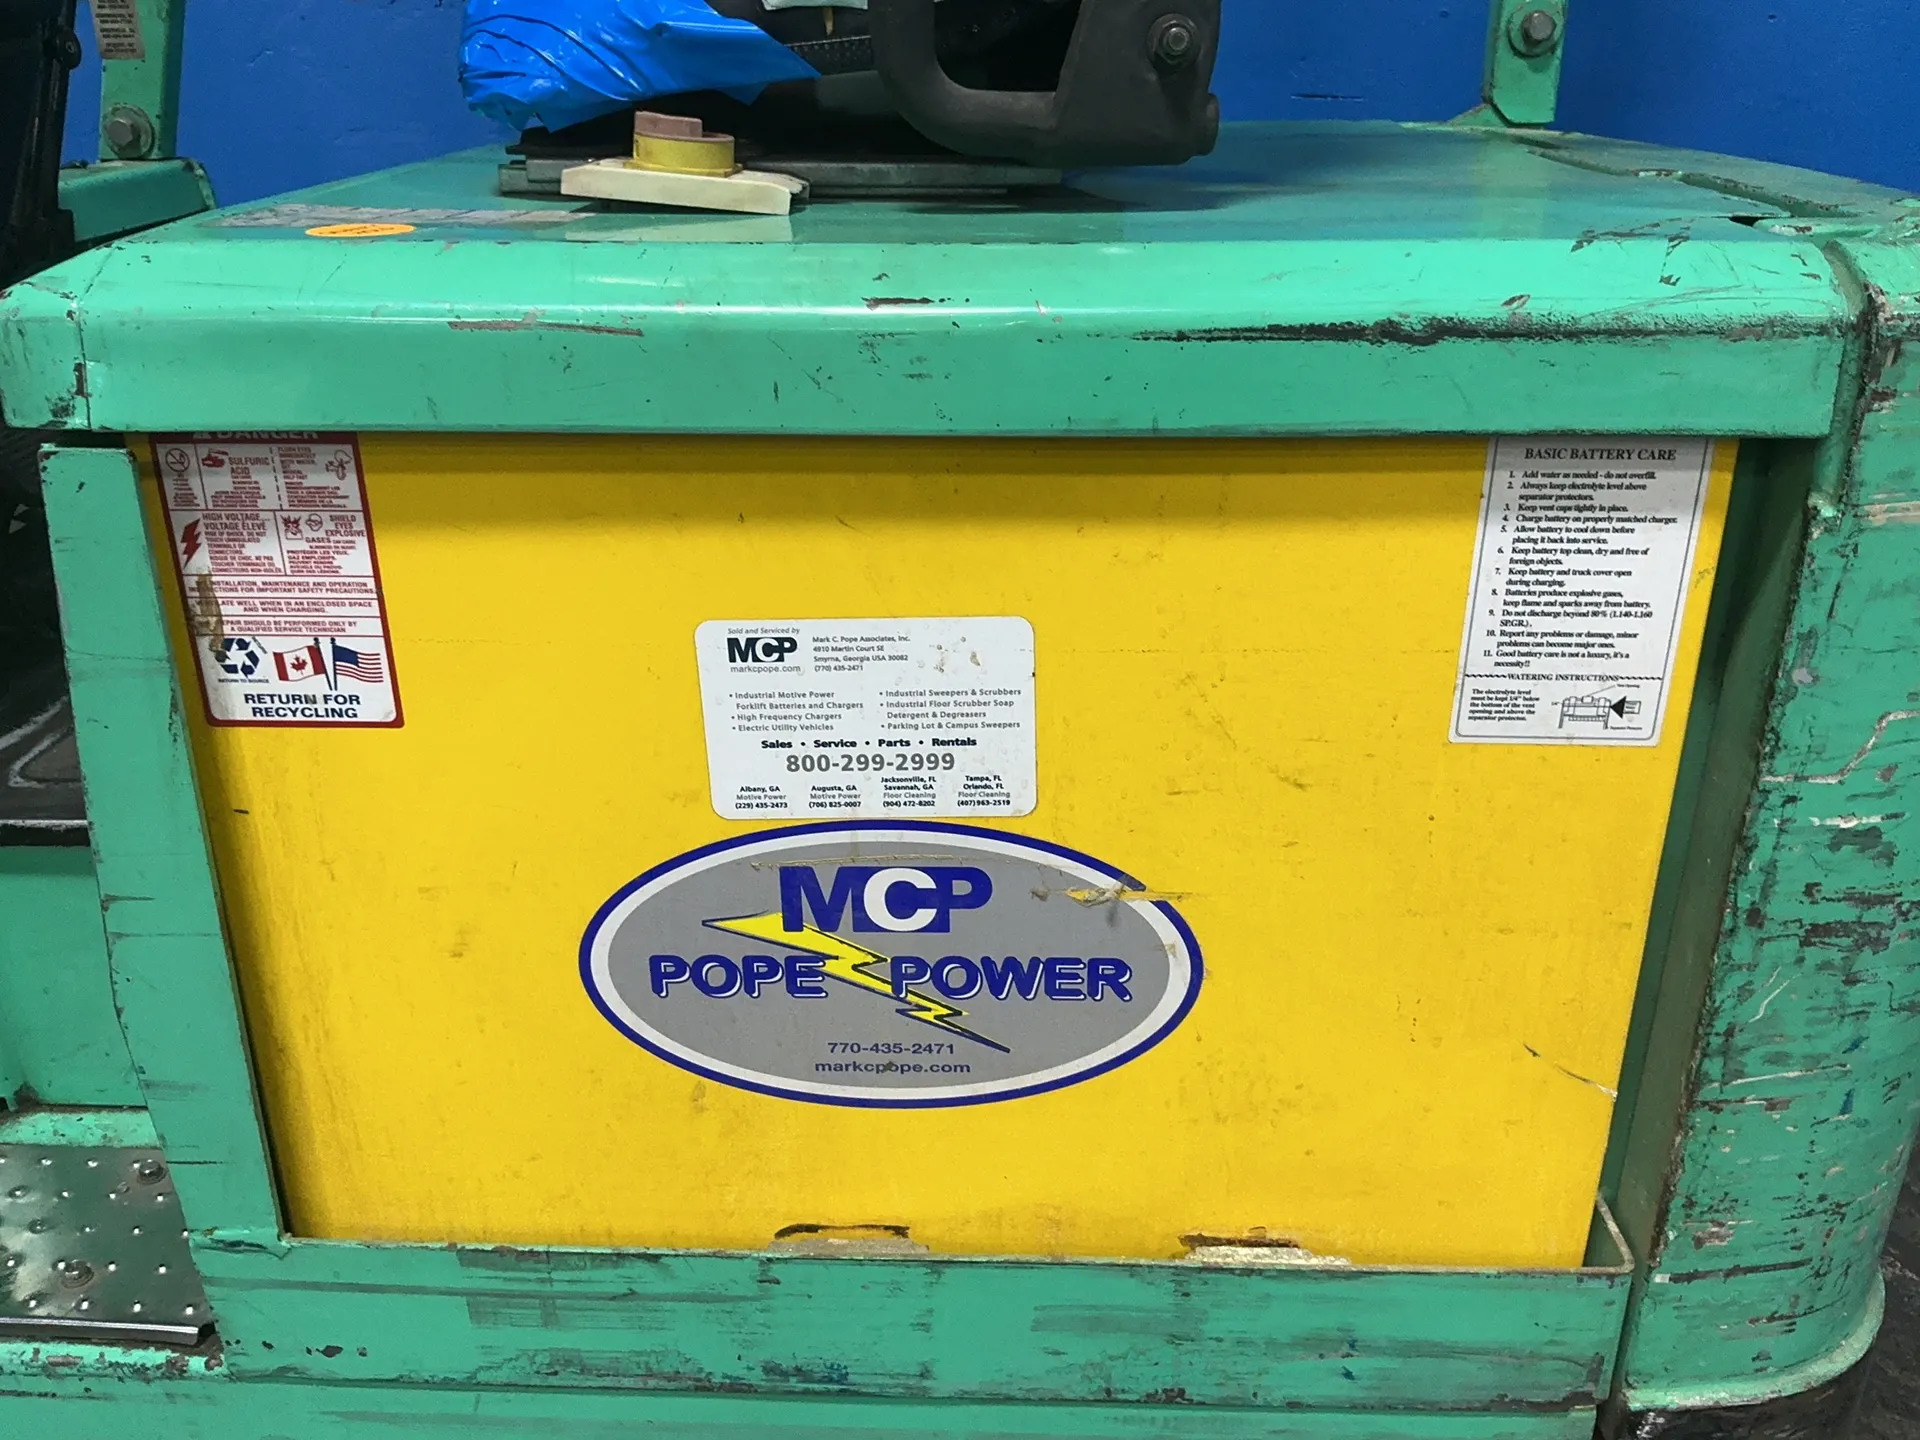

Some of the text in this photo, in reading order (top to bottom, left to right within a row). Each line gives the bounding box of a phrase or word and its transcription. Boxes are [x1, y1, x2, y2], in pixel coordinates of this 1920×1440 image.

[1524, 448, 1677, 461] BASIC BATTERY CARE
[228, 457, 270, 465] SULFURIC
[231, 467, 250, 475] ACID
[203, 522, 240, 530] VOLTAGE
[335, 522, 353, 530] EYES
[325, 529, 366, 537] EXPLOSIVE
[1503, 600, 1520, 608] keep
[1559, 600, 1582, 608] sparks
[1604, 600, 1622, 608] from
[1624, 601, 1651, 609] battery.
[1527, 610, 1562, 618] discharge
[1563, 610, 1589, 618] beyond
[791, 627, 800, 635] by
[1500, 630, 1525, 639] Report
[1540, 630, 1574, 639] problems
[1585, 631, 1615, 639] damage,
[840, 636, 858, 644] Pope
[1497, 640, 1530, 649] problems
[1574, 641, 1596, 650] major
[727, 637, 798, 663] MCP
[730, 665, 800, 673] markcpope.com
[928, 689, 969, 698] Sweepers
[979, 688, 1022, 696] Scrubbers
[244, 694, 361, 705] RETURN FOR
[993, 700, 1014, 708] Soap
[736, 702, 767, 710] Forklift
[826, 702, 863, 710] Chargers
[252, 707, 358, 719] RECYCLING
[737, 713, 842, 722] High Frequency Chargers
[887, 711, 929, 720] Detergent
[940, 711, 987, 720] Degreasers
[738, 724, 769, 732] Electric
[771, 724, 797, 732] Utility
[887, 722, 919, 731] Parking
[945, 721, 979, 730] Campus
[981, 721, 1020, 729] Sweepers
[761, 737, 977, 749] Sales Service Parts Rentals
[786, 752, 955, 772] 800-299-2999
[881, 776, 927, 784] Jacksonville,
[808, 801, 827, 809] (706)
[780, 866, 993, 933] MCP
[650, 955, 1133, 1001] POPE POWER
[827, 1042, 955, 1055] 770-435-2471
[815, 1060, 971, 1076] markcpope.com
